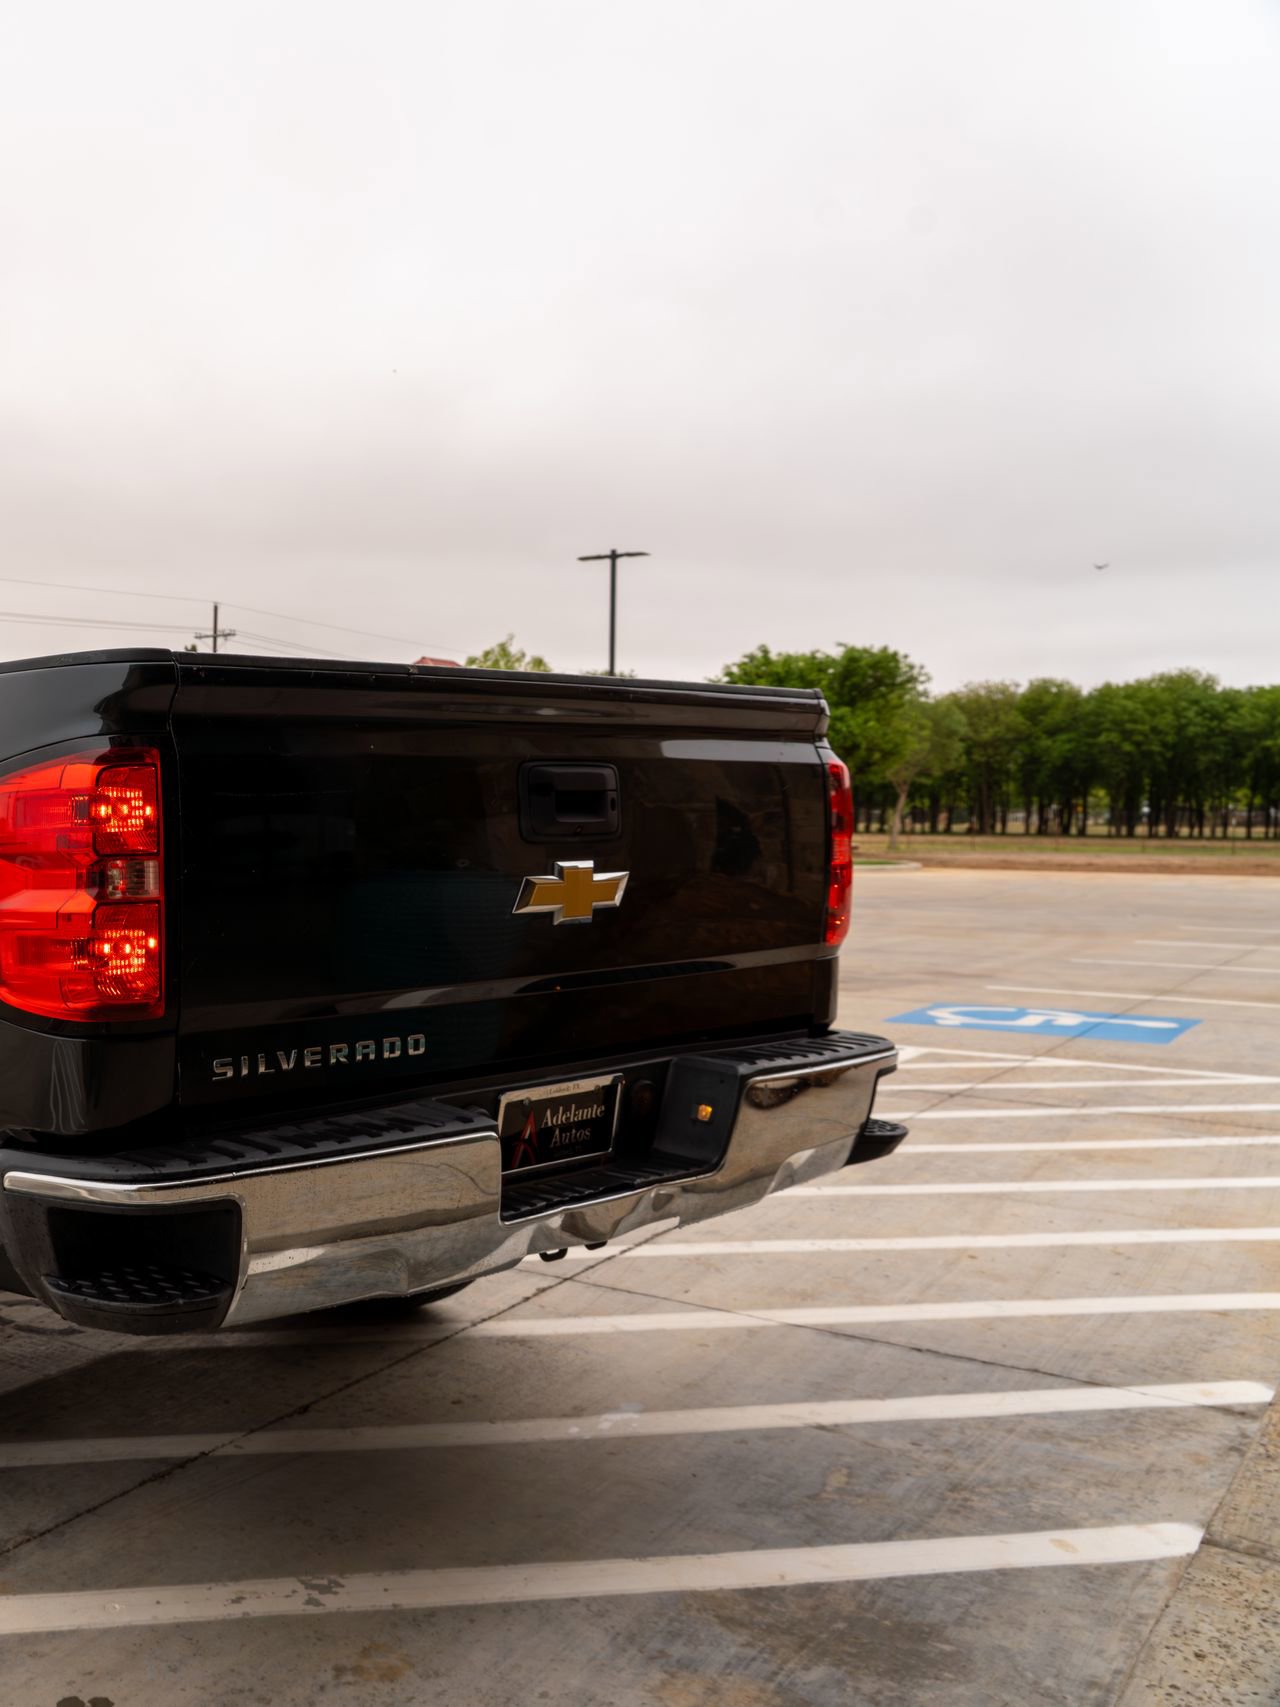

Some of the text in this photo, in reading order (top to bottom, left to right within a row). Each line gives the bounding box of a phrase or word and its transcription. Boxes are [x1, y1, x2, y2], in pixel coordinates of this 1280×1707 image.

[211, 1034, 427, 1081] SILVERADO
[540, 1103, 606, 1129] Adelante
[550, 1127, 592, 1148] Autos
